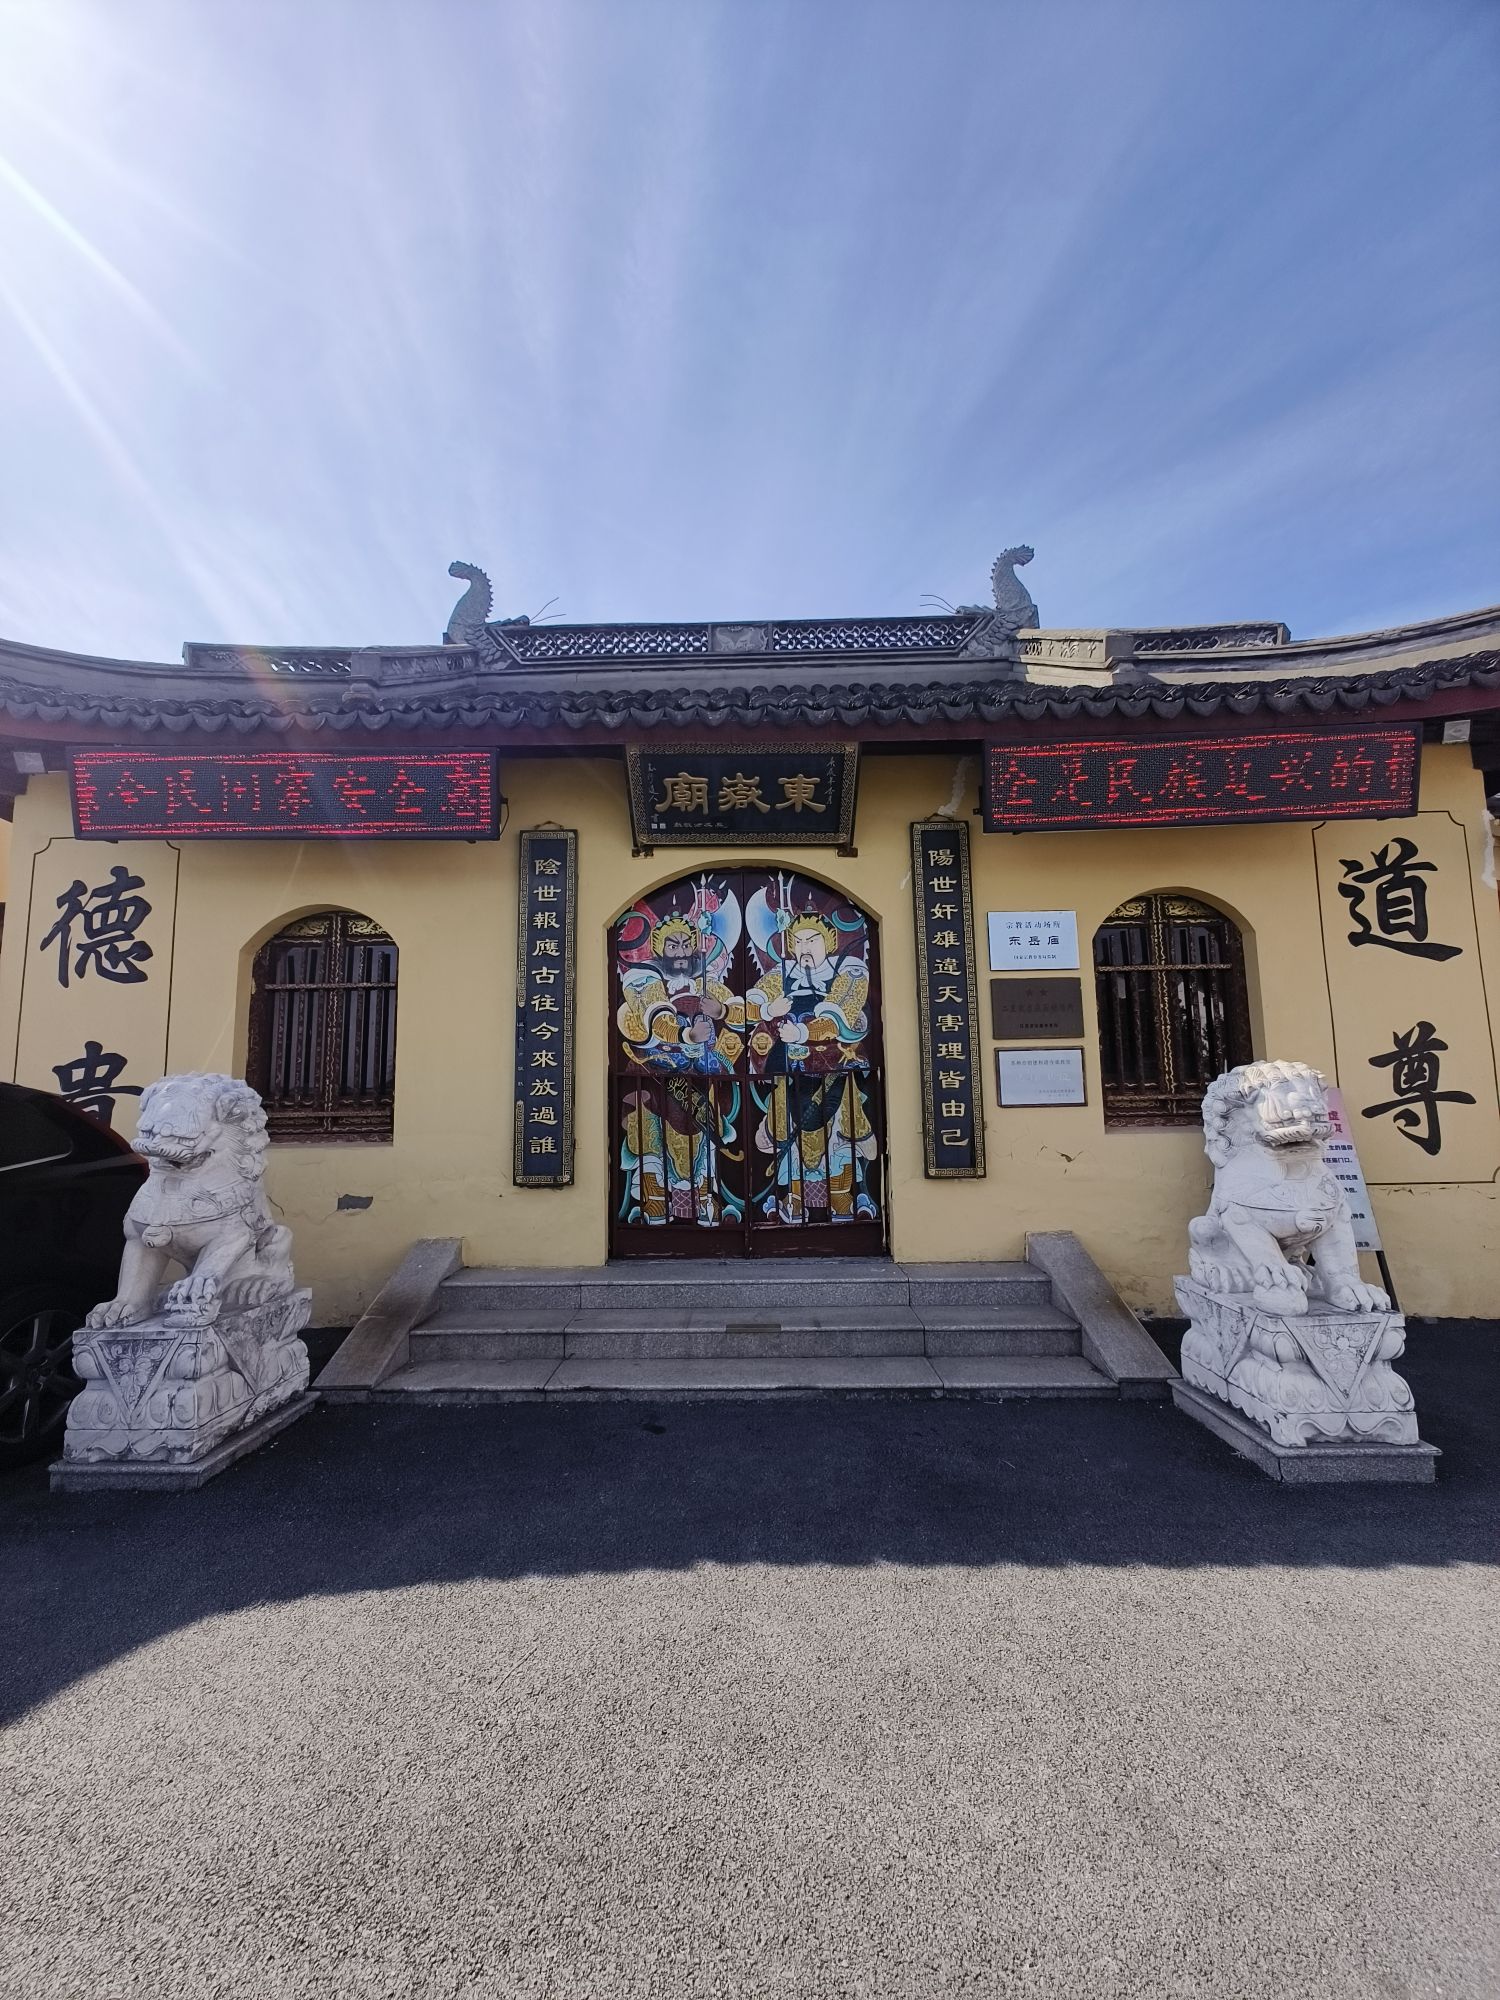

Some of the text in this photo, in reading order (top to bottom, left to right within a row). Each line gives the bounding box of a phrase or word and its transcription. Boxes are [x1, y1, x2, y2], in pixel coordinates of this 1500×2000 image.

[528, 858, 562, 1155] 陰世報應古往今來放過誰
[927, 848, 970, 1147] 陽世奸雄違天害理皆由己
[1008, 935, 1060, 946] 东岳庙
